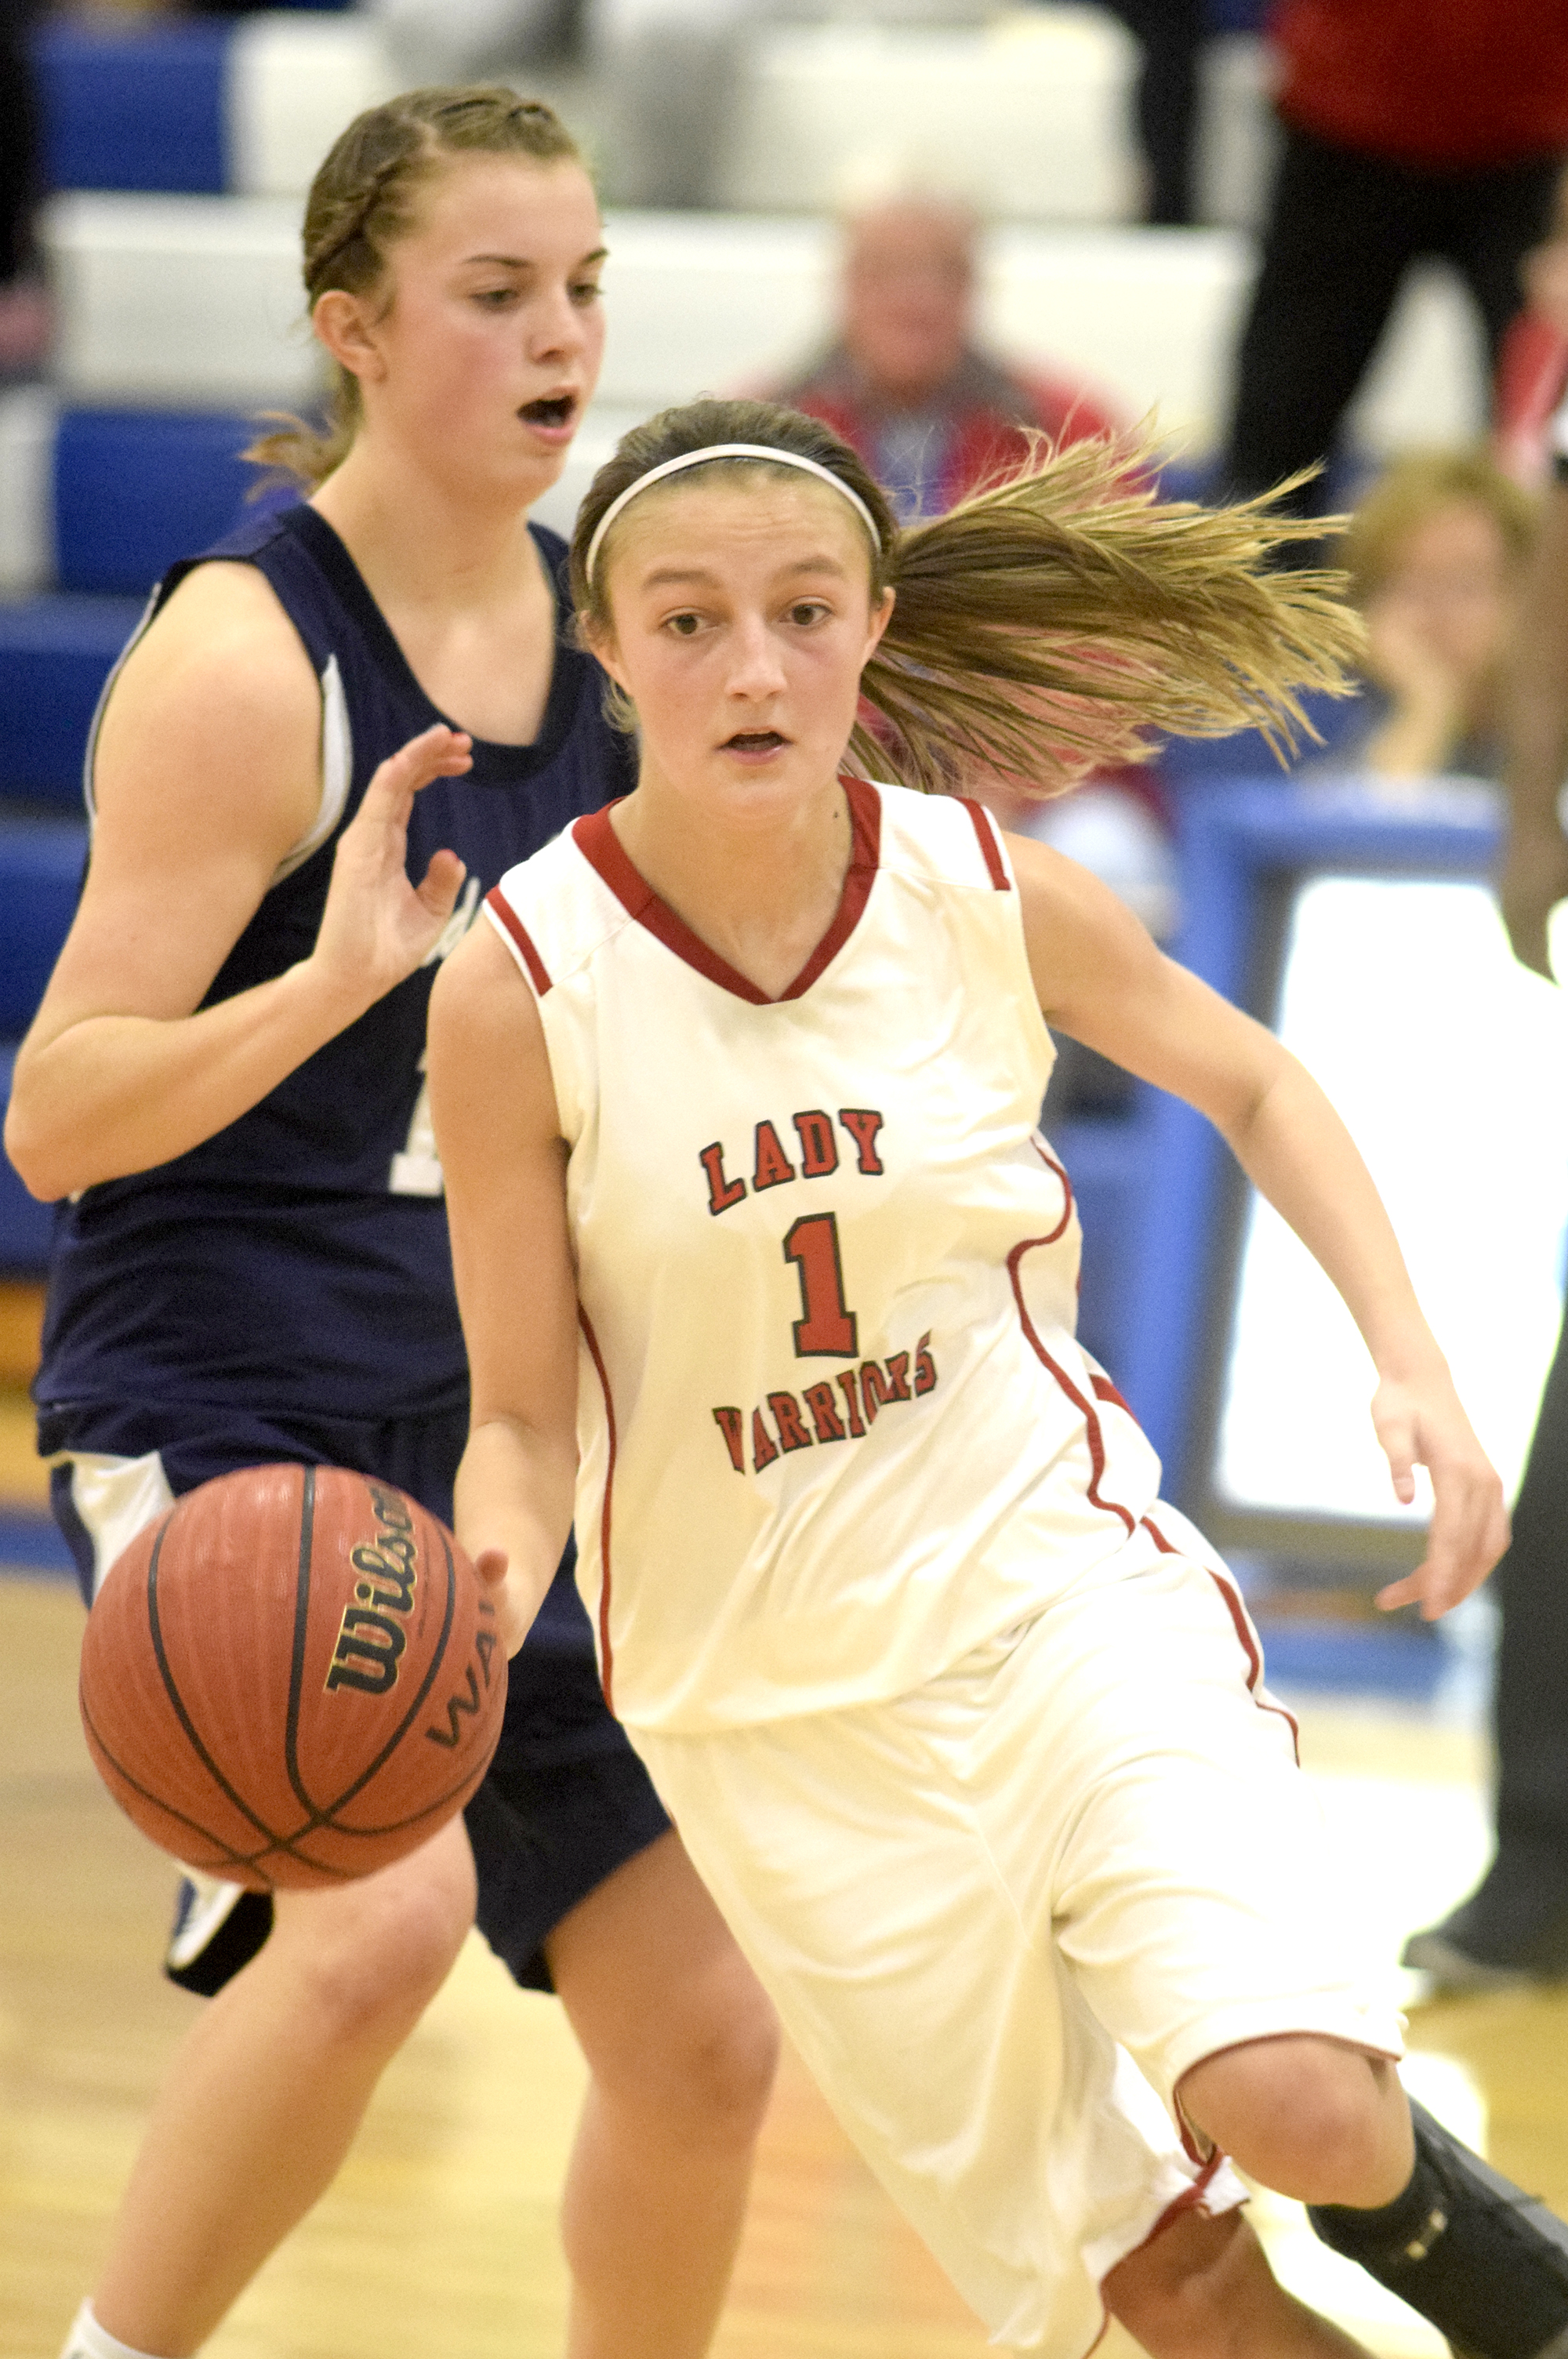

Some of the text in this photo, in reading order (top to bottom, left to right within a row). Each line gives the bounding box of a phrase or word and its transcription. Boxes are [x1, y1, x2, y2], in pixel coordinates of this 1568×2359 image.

[700, 1109, 884, 1216] LADY
[782, 1211, 859, 1358] 1
[323, 1480, 417, 1696] Wilso
